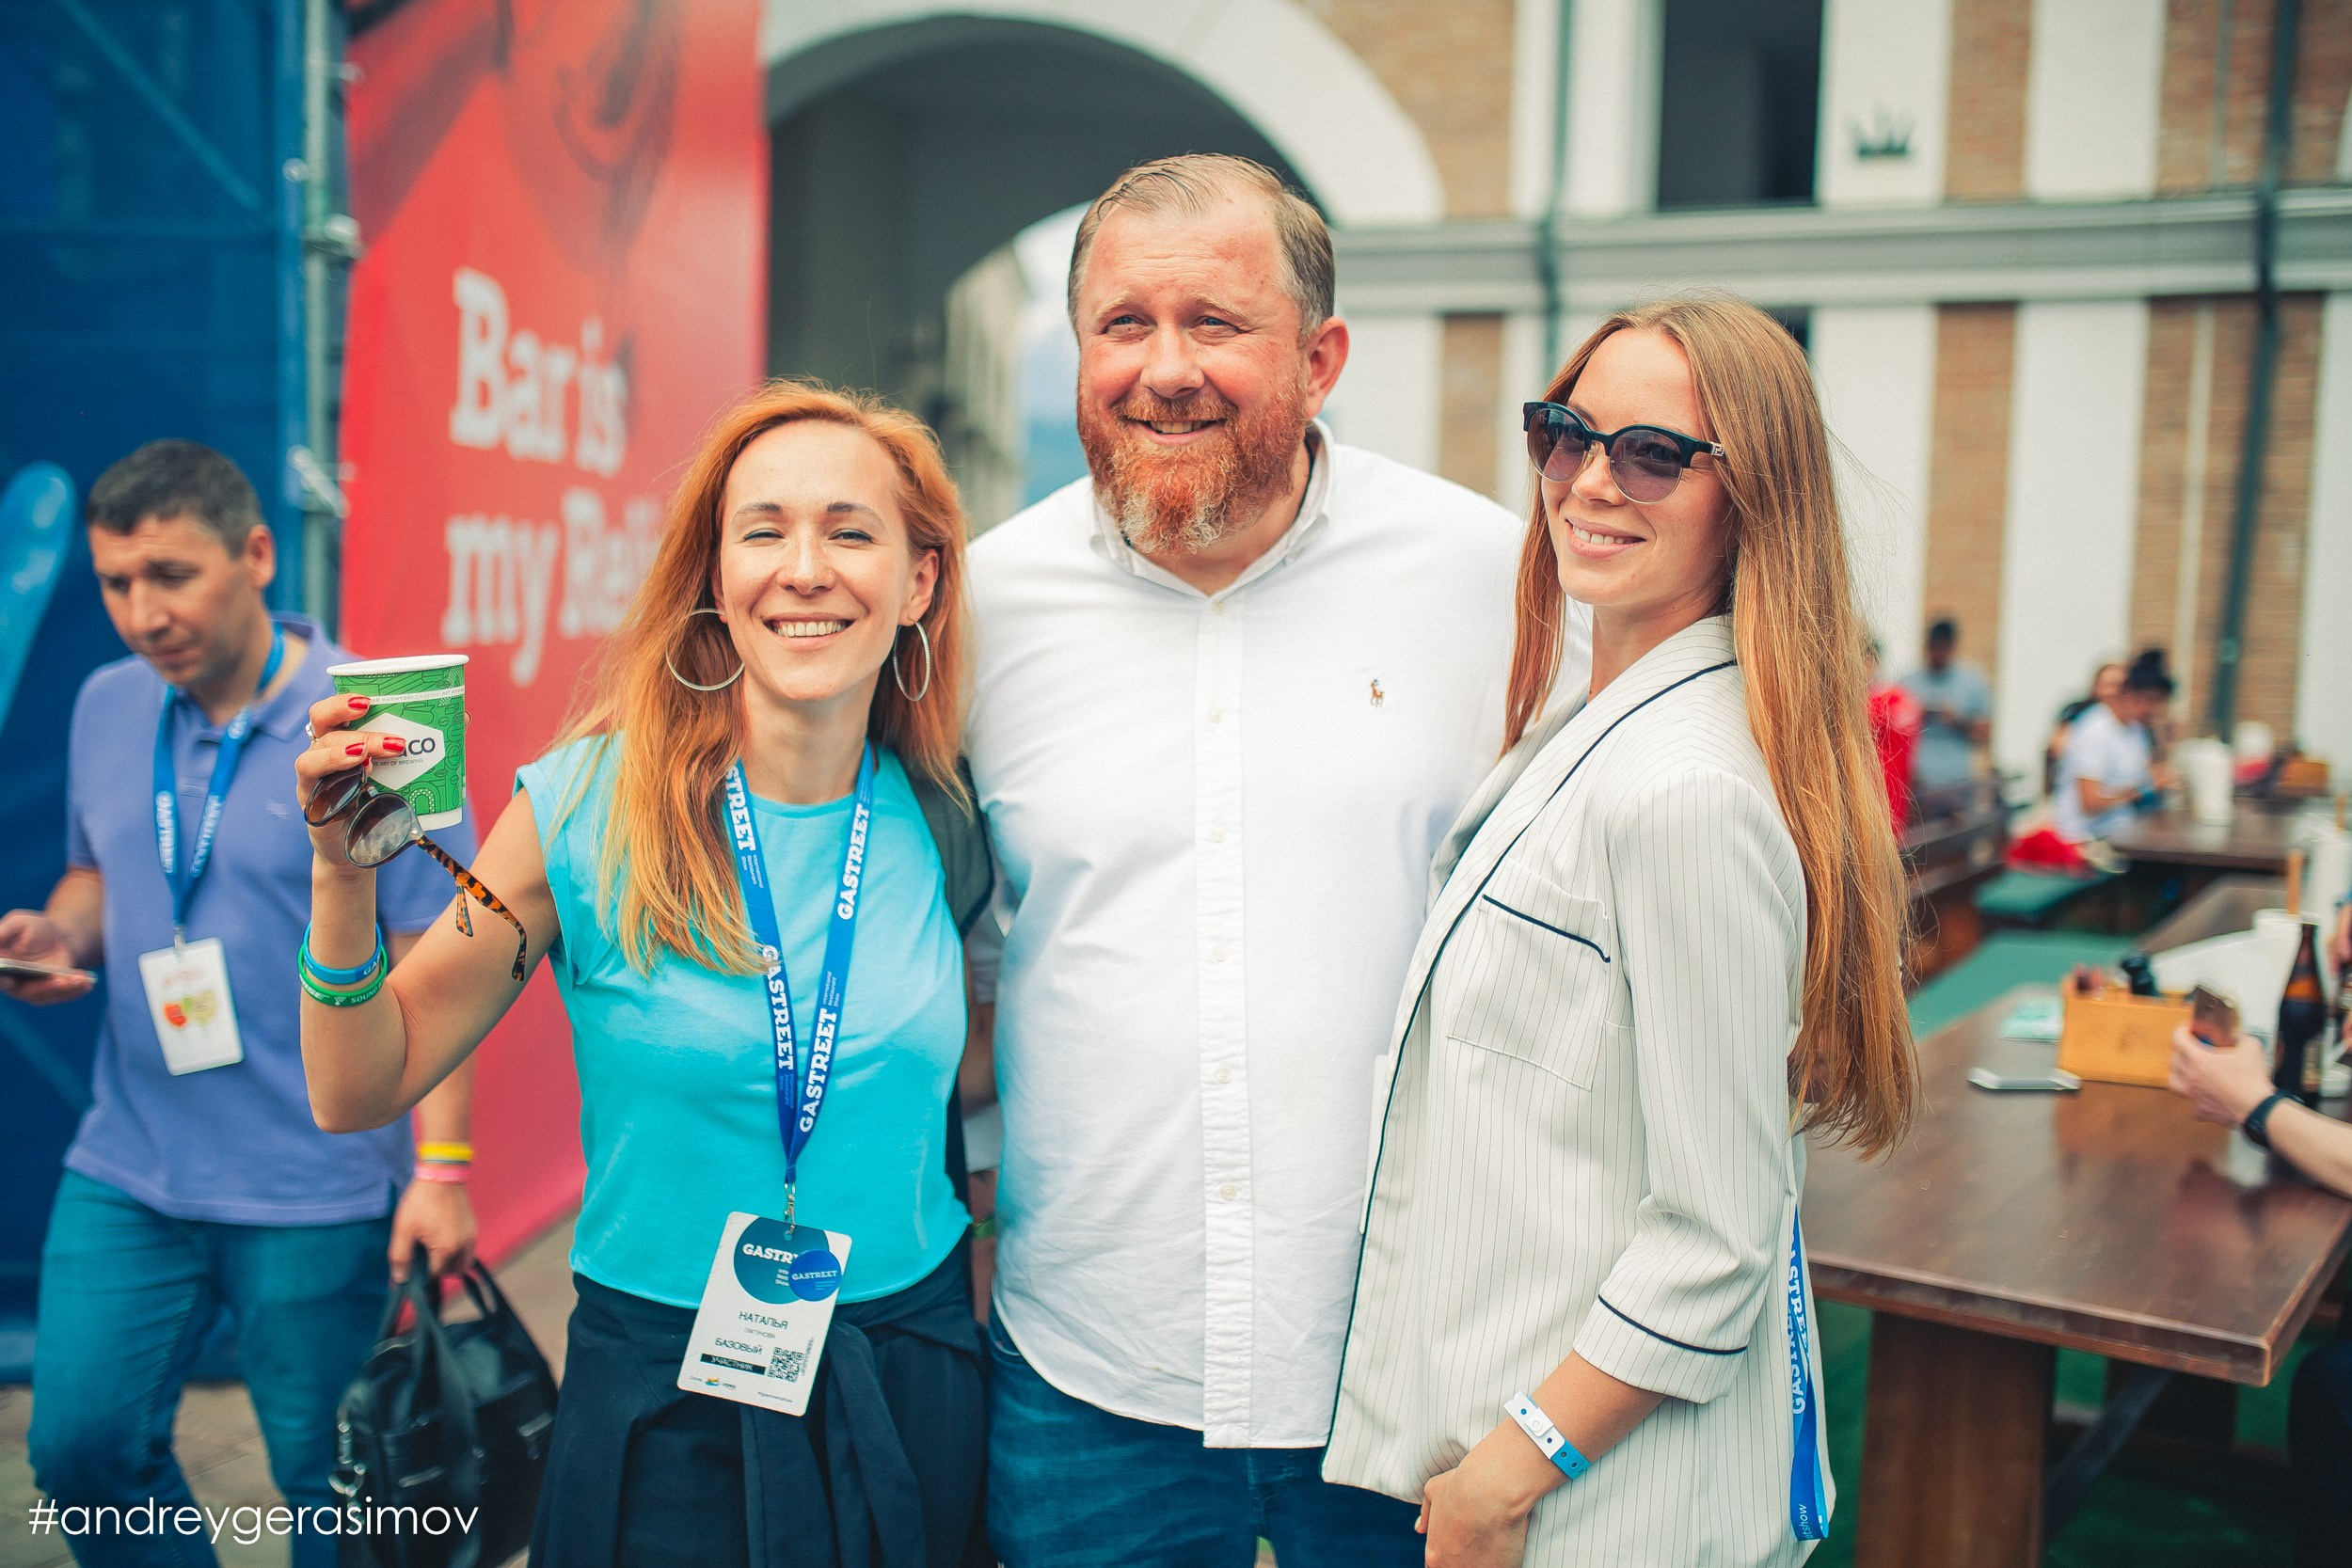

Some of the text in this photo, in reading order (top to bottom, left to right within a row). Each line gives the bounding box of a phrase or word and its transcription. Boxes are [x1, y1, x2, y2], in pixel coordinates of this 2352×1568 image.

[450, 266, 629, 478] Bar is
[440, 515, 560, 689] my
[837, 803, 870, 921] GASTREET
[763, 945, 794, 1070] GASTREET
[799, 1007, 837, 1133] GASTREET
[742, 1243, 799, 1265] GASTR
[791, 1270, 839, 1281] GASTREET
[715, 1337, 763, 1354] БАЗОВЫЙ
[739, 1311, 789, 1330] НАТАЛЬЯ
[710, 1355, 754, 1371] УЧАСТНИК
